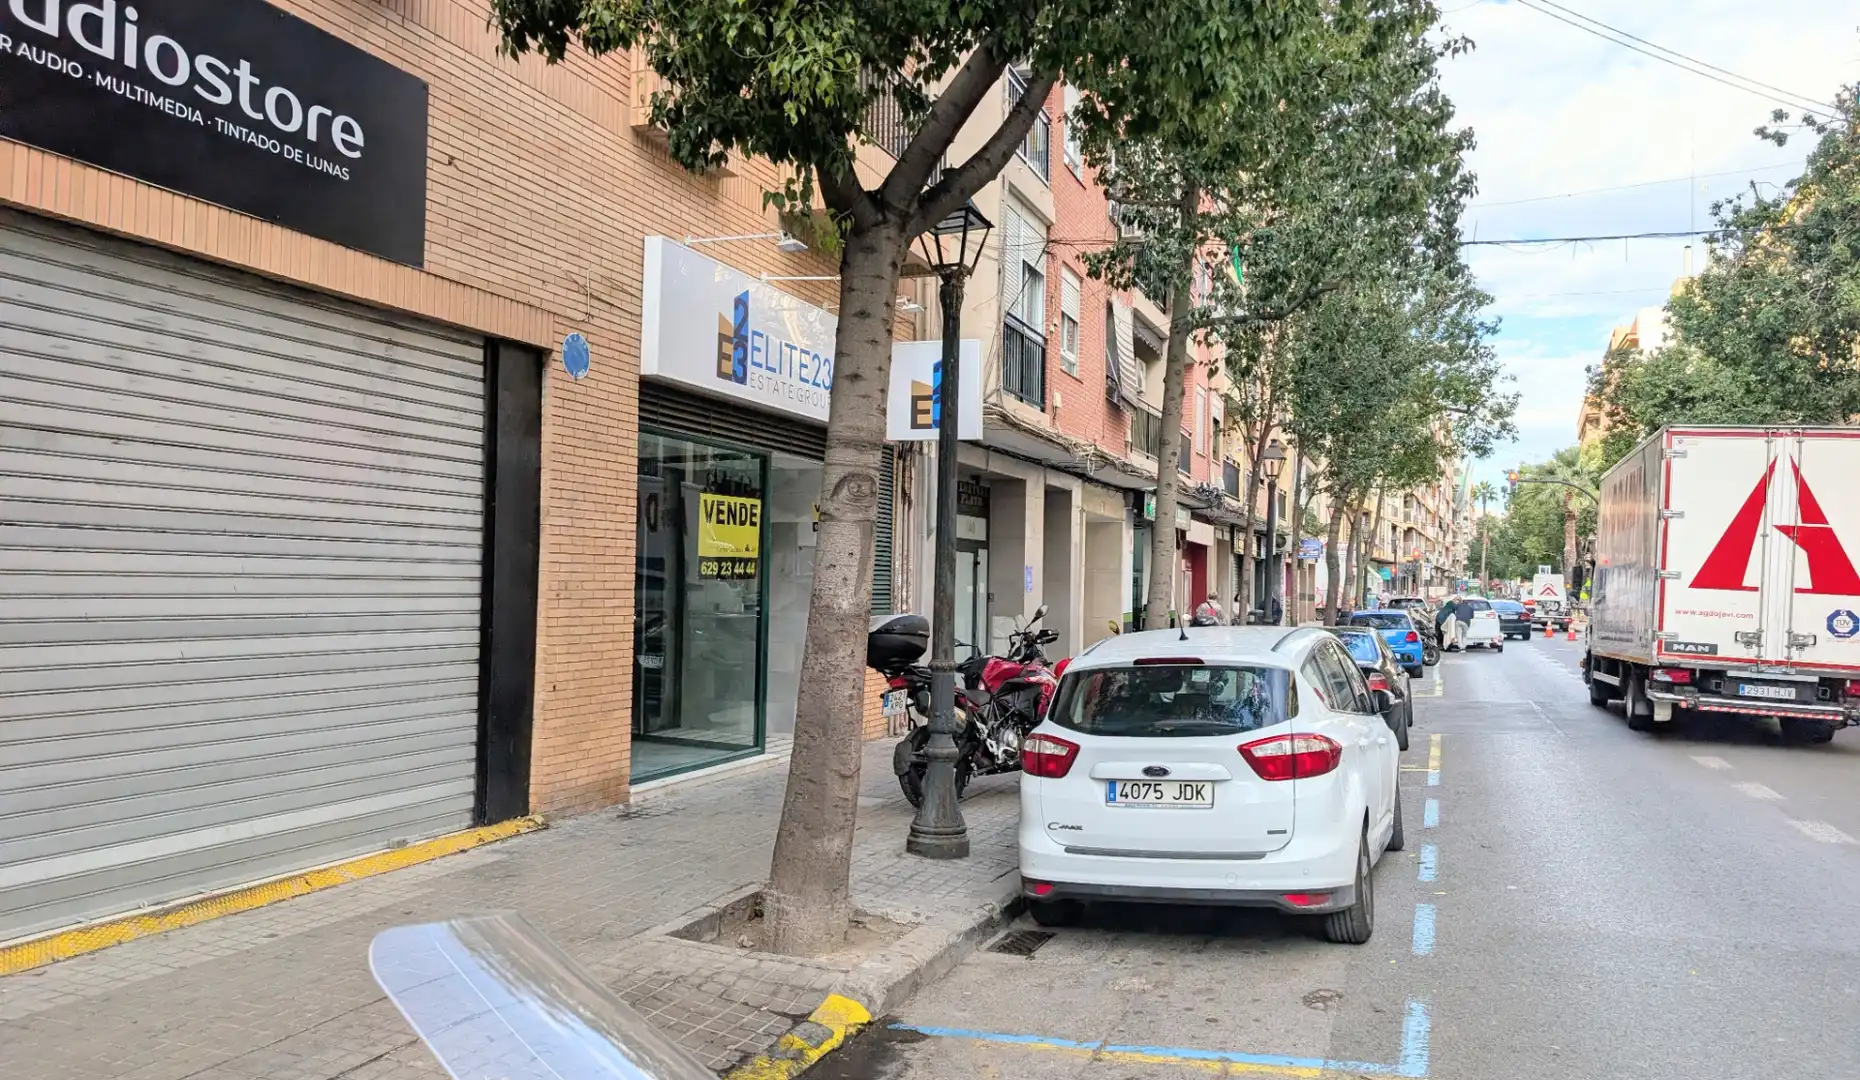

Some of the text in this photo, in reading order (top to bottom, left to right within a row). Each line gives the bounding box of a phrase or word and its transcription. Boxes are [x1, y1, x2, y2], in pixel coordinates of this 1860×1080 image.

[16, 41, 83, 78] AUDIO
[95, 70, 204, 126] MULTIMEDIA
[214, 117, 281, 154] TINTADO
[283, 144, 303, 164] DE
[306, 153, 350, 181] LUNAS
[750, 330, 833, 391] ELITE23
[750, 371, 794, 400] ESTATE
[703, 498, 759, 528] VENDE
[701, 561, 756, 576] 629 23 44 44
[1672, 643, 1710, 653] MAN
[1746, 686, 1770, 697] 2931
[1119, 782, 1206, 801] 4075 JDK
